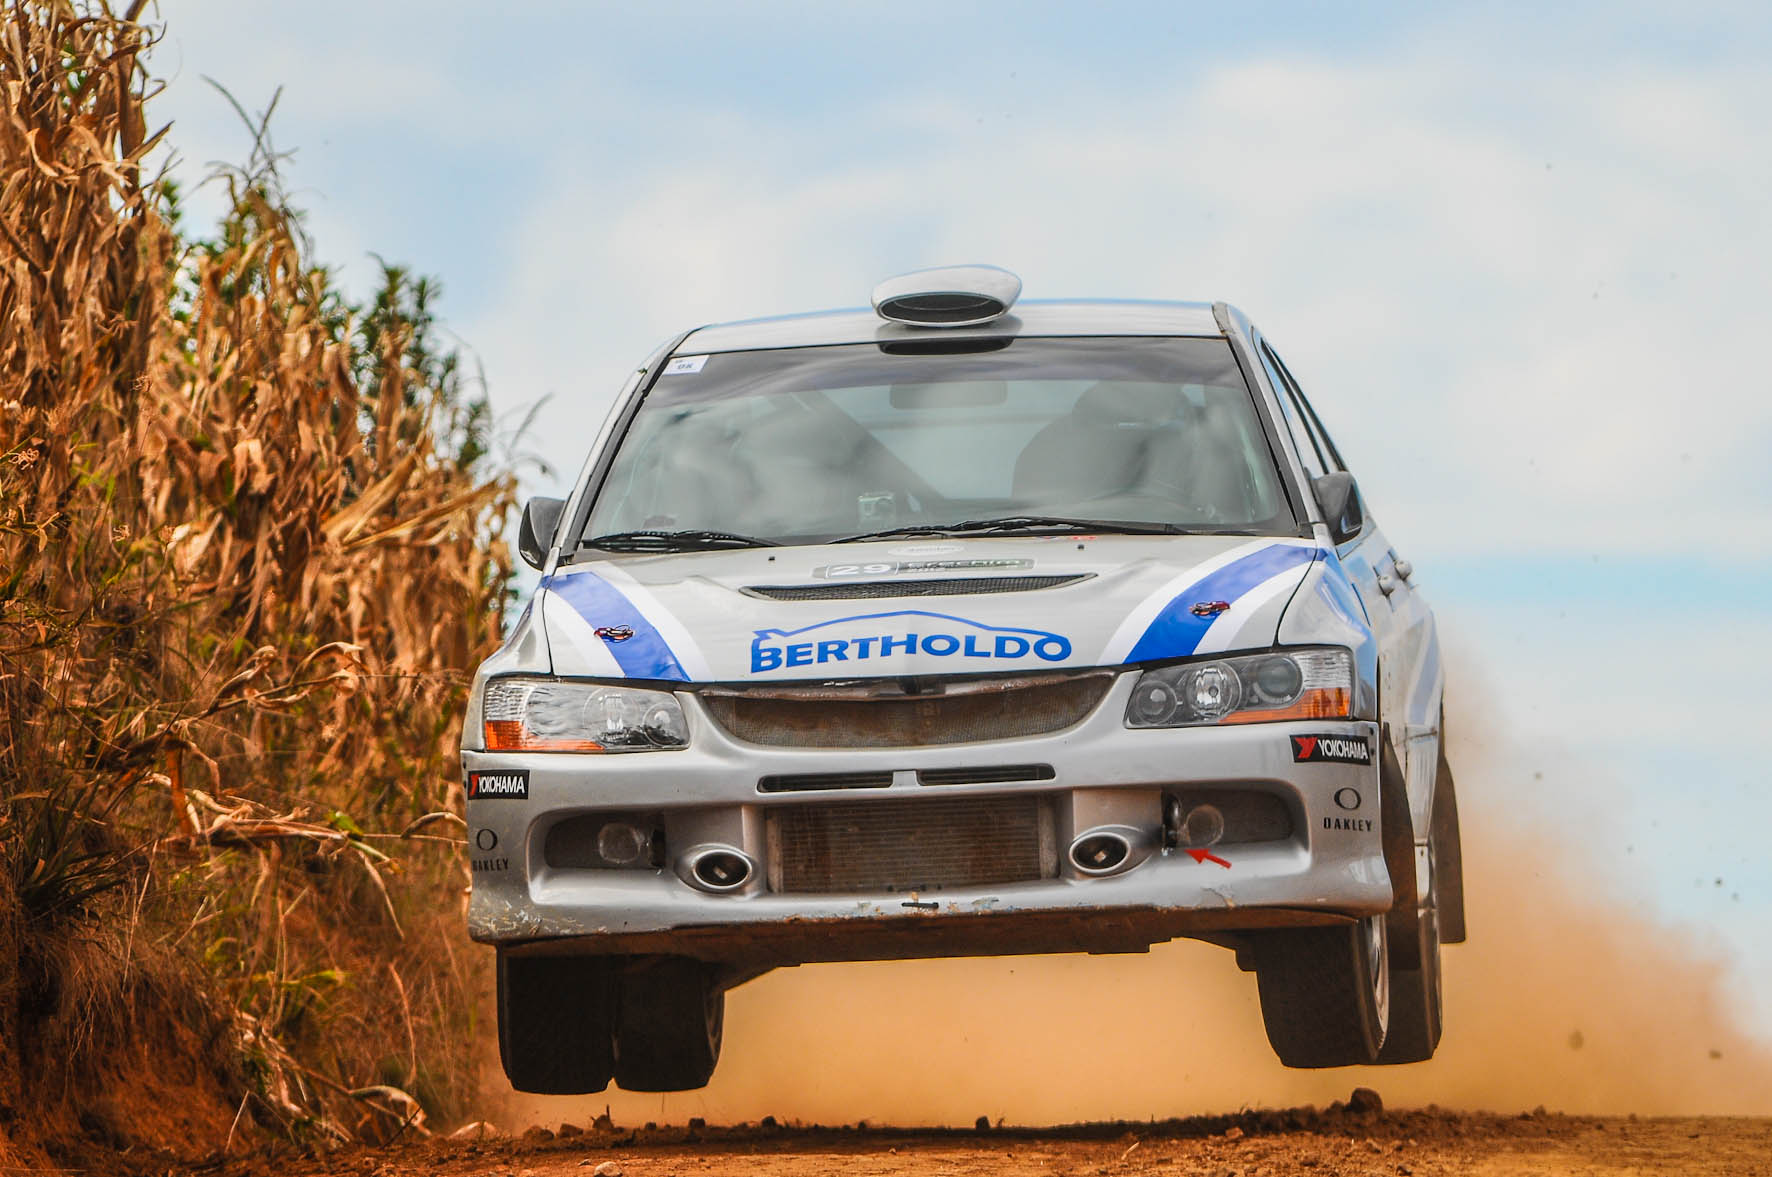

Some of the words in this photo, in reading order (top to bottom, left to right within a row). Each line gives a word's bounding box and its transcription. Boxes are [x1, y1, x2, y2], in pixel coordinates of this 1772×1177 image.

[831, 564, 891, 576] 29
[751, 632, 1072, 673] BERTHOLDO
[1317, 739, 1368, 760] YOKOHAMA
[478, 775, 525, 793] YOKOHAMA
[1323, 816, 1372, 832] OAKLEY
[472, 858, 509, 872] OAKLEY
